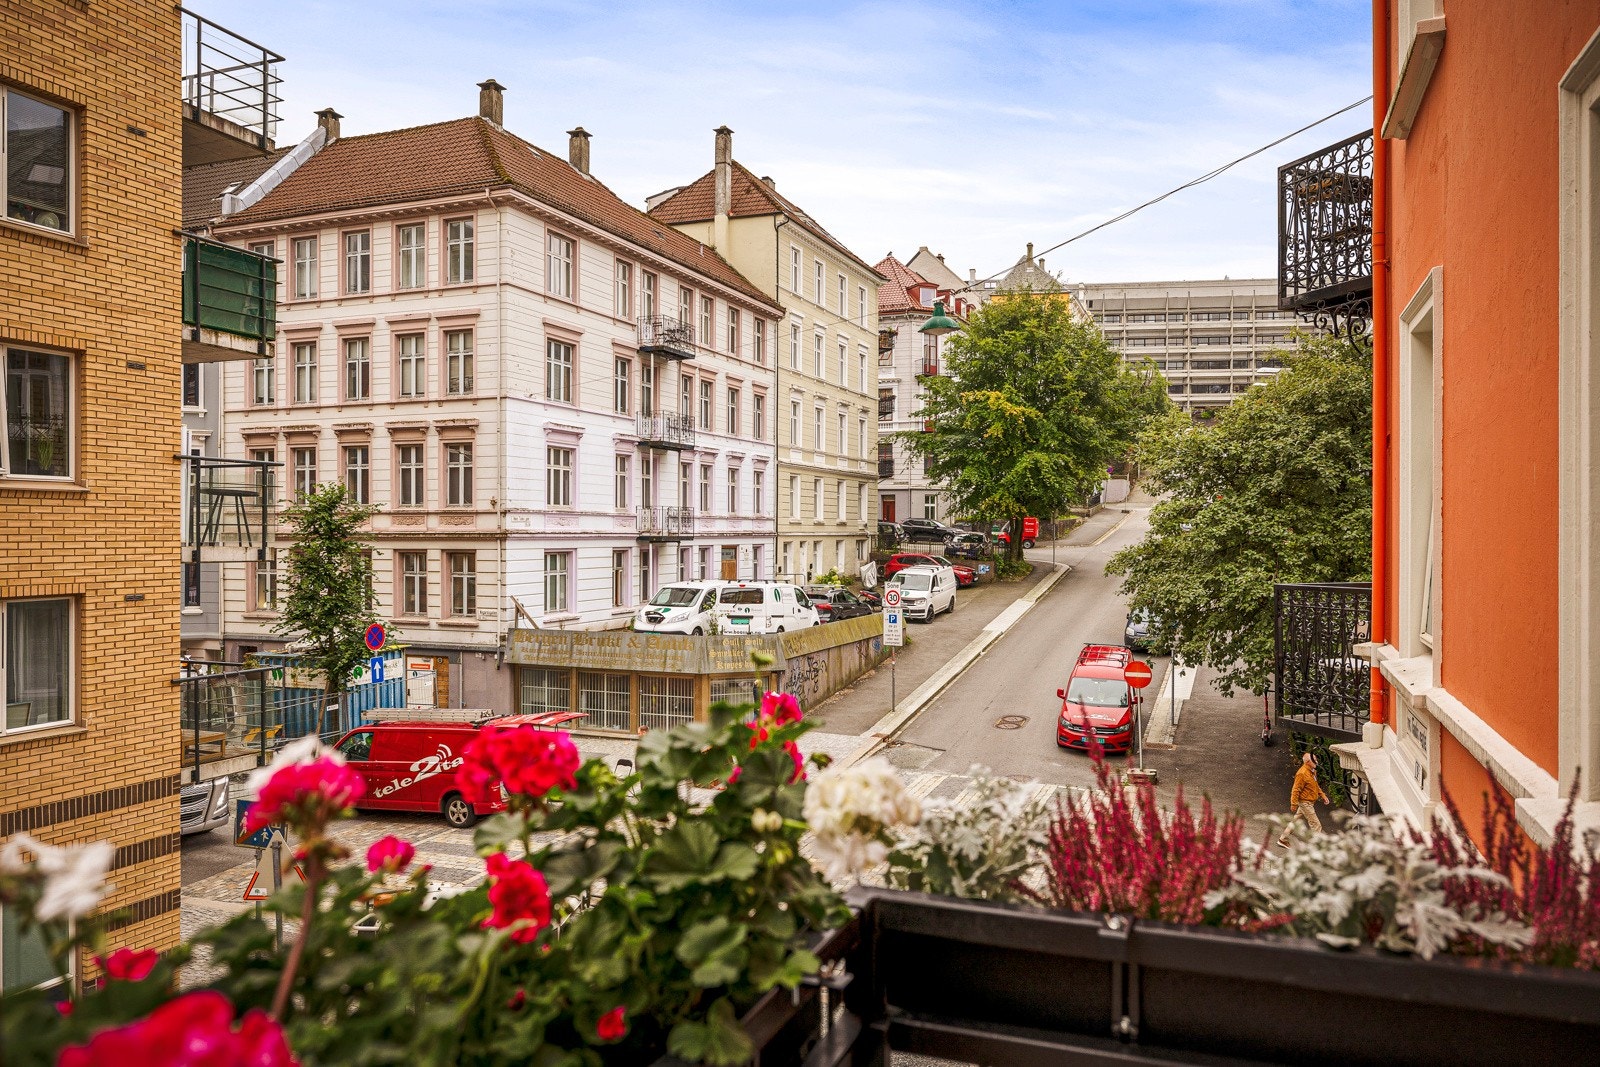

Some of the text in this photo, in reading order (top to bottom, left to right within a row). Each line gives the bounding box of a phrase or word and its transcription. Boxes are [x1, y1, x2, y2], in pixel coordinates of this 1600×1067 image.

[889, 594, 897, 602] 30
[514, 630, 567, 646] Bergen
[627, 635, 641, 649] &
